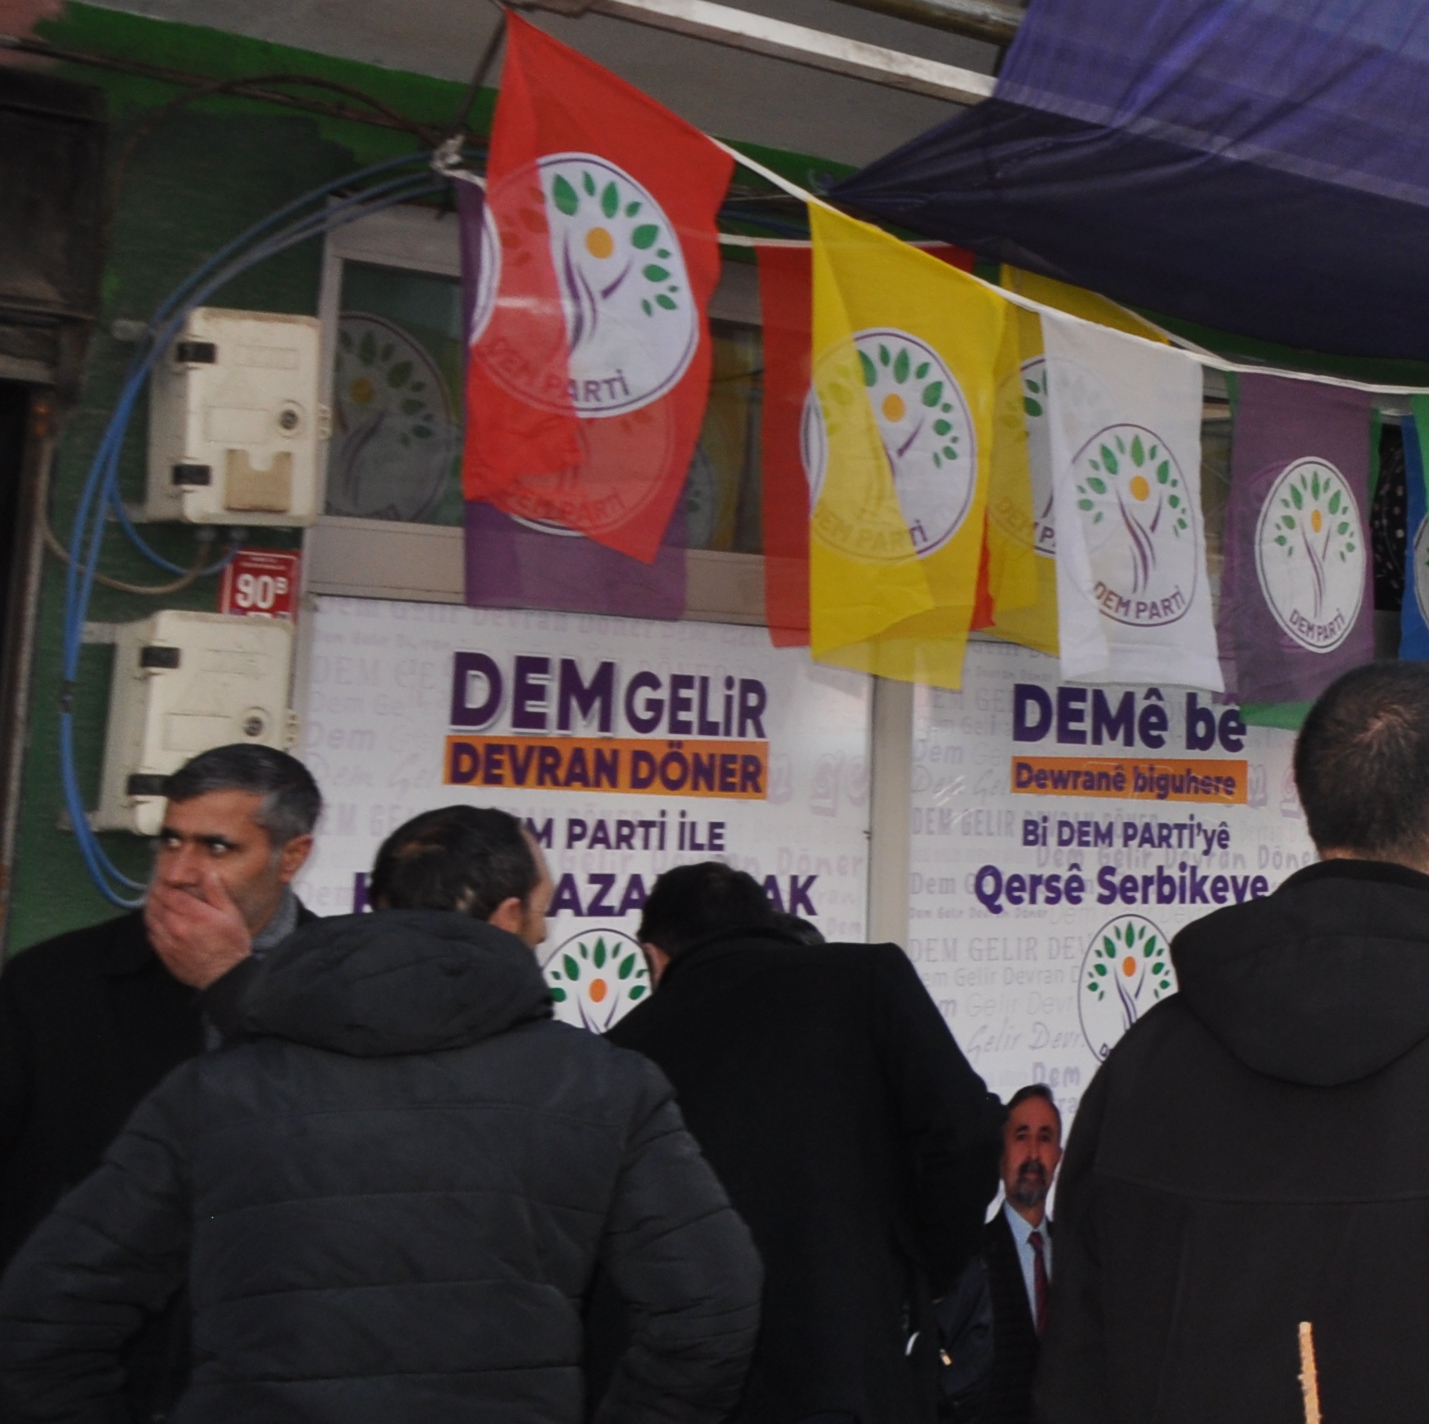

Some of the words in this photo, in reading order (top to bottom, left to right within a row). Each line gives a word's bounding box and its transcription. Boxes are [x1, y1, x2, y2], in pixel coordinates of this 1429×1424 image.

[1092, 579, 1131, 616] DEM
[1135, 584, 1186, 620] PARTİ
[1288, 608, 1317, 641] DEM
[1315, 607, 1346, 643] PARTİ
[449, 651, 618, 735] DEM
[1013, 684, 1169, 751] DEMê
[450, 741, 620, 788] DEVRAN
[630, 739, 763, 794] DÖNER
[1014, 762, 1127, 794] Dewranê
[565, 808, 668, 852] PARTİ
[677, 808, 727, 852] İLE
[1057, 819, 1114, 849] DEM
[974, 862, 1085, 915] Qersê
